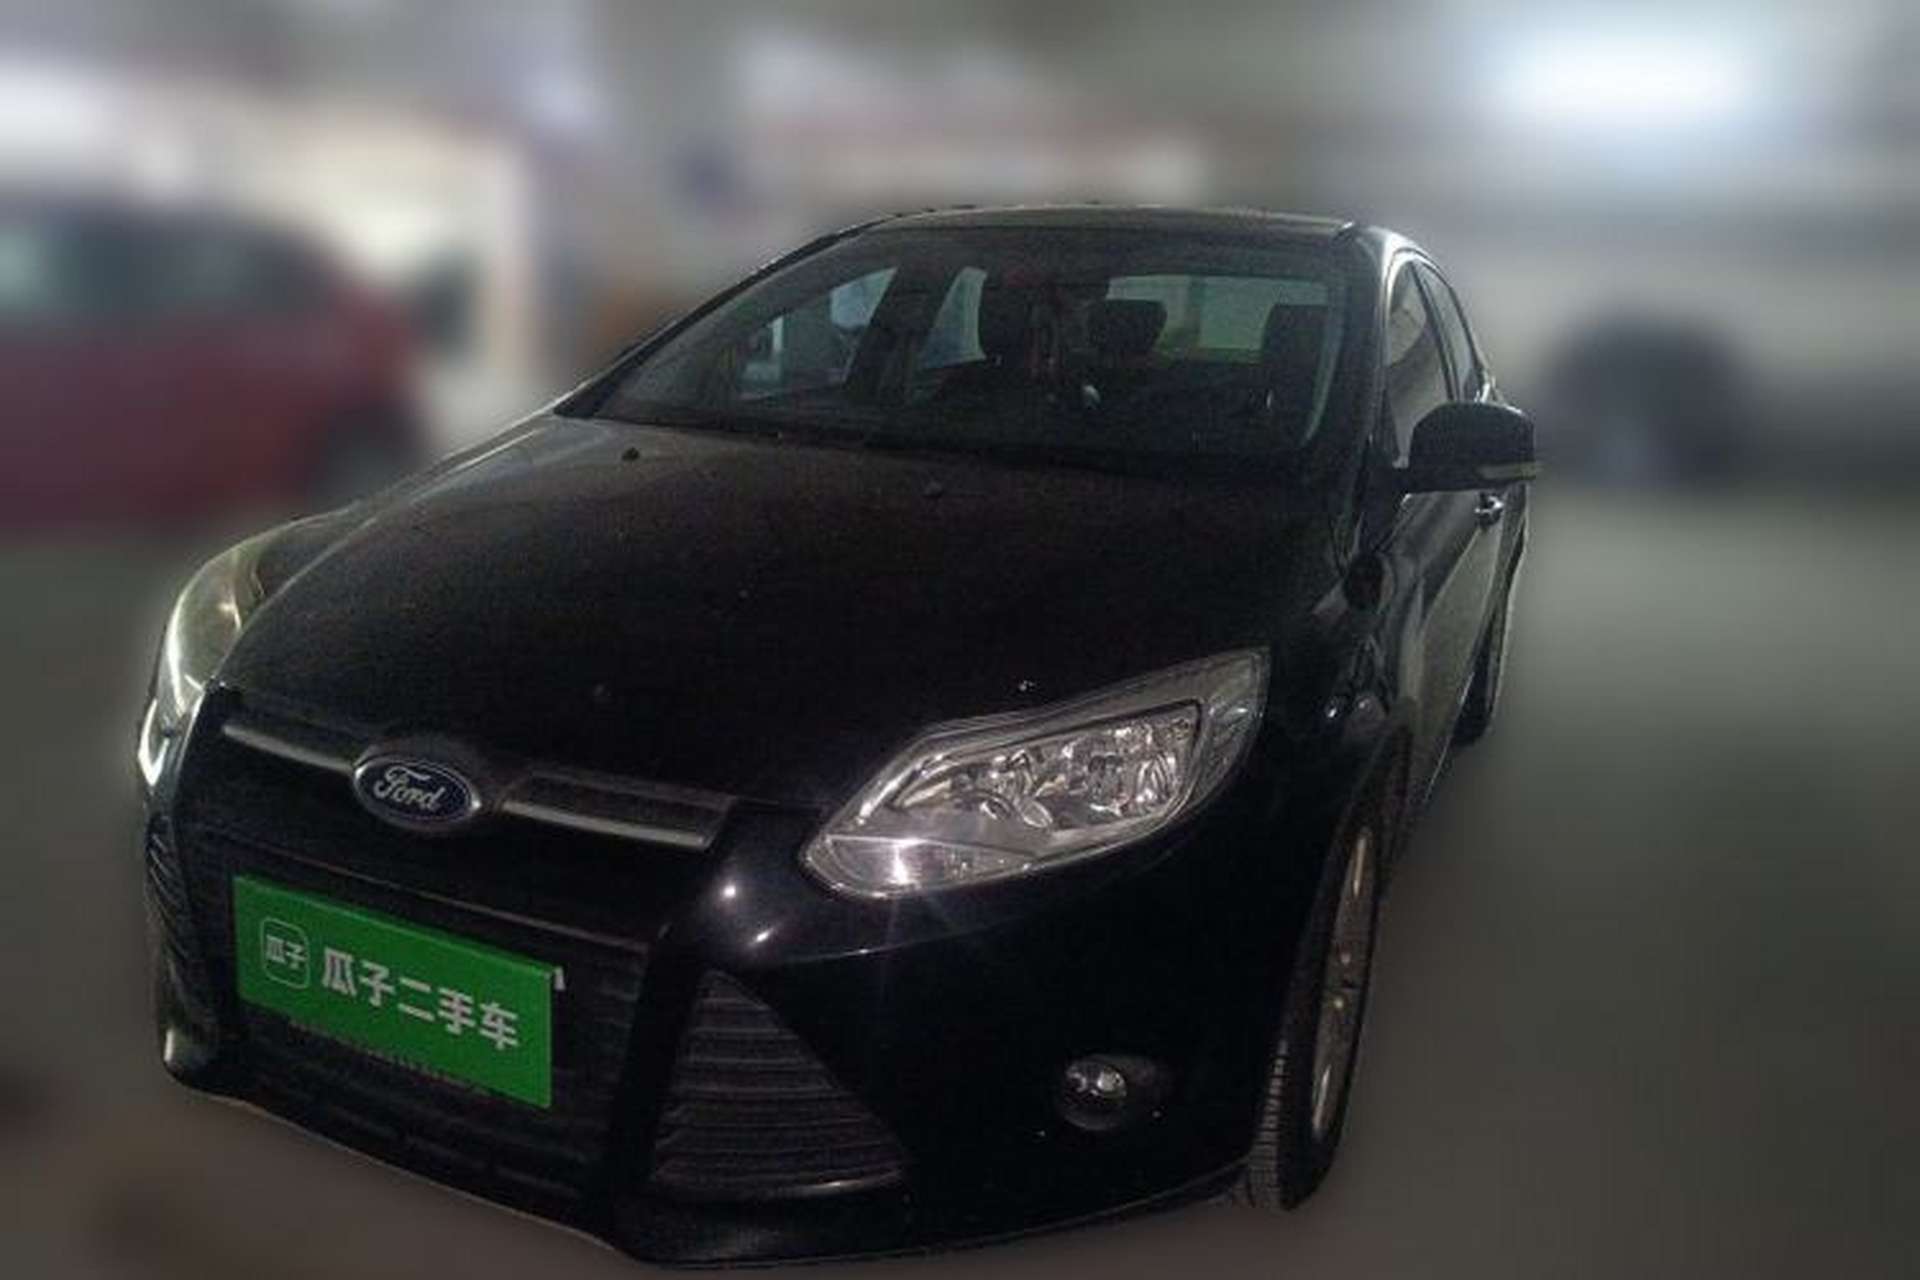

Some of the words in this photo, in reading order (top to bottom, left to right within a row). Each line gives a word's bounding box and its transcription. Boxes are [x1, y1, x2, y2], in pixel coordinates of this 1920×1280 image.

[373, 766, 446, 811] Ford
[265, 935, 306, 970] 瓜子
[321, 947, 519, 1050] 瓜子二手车
